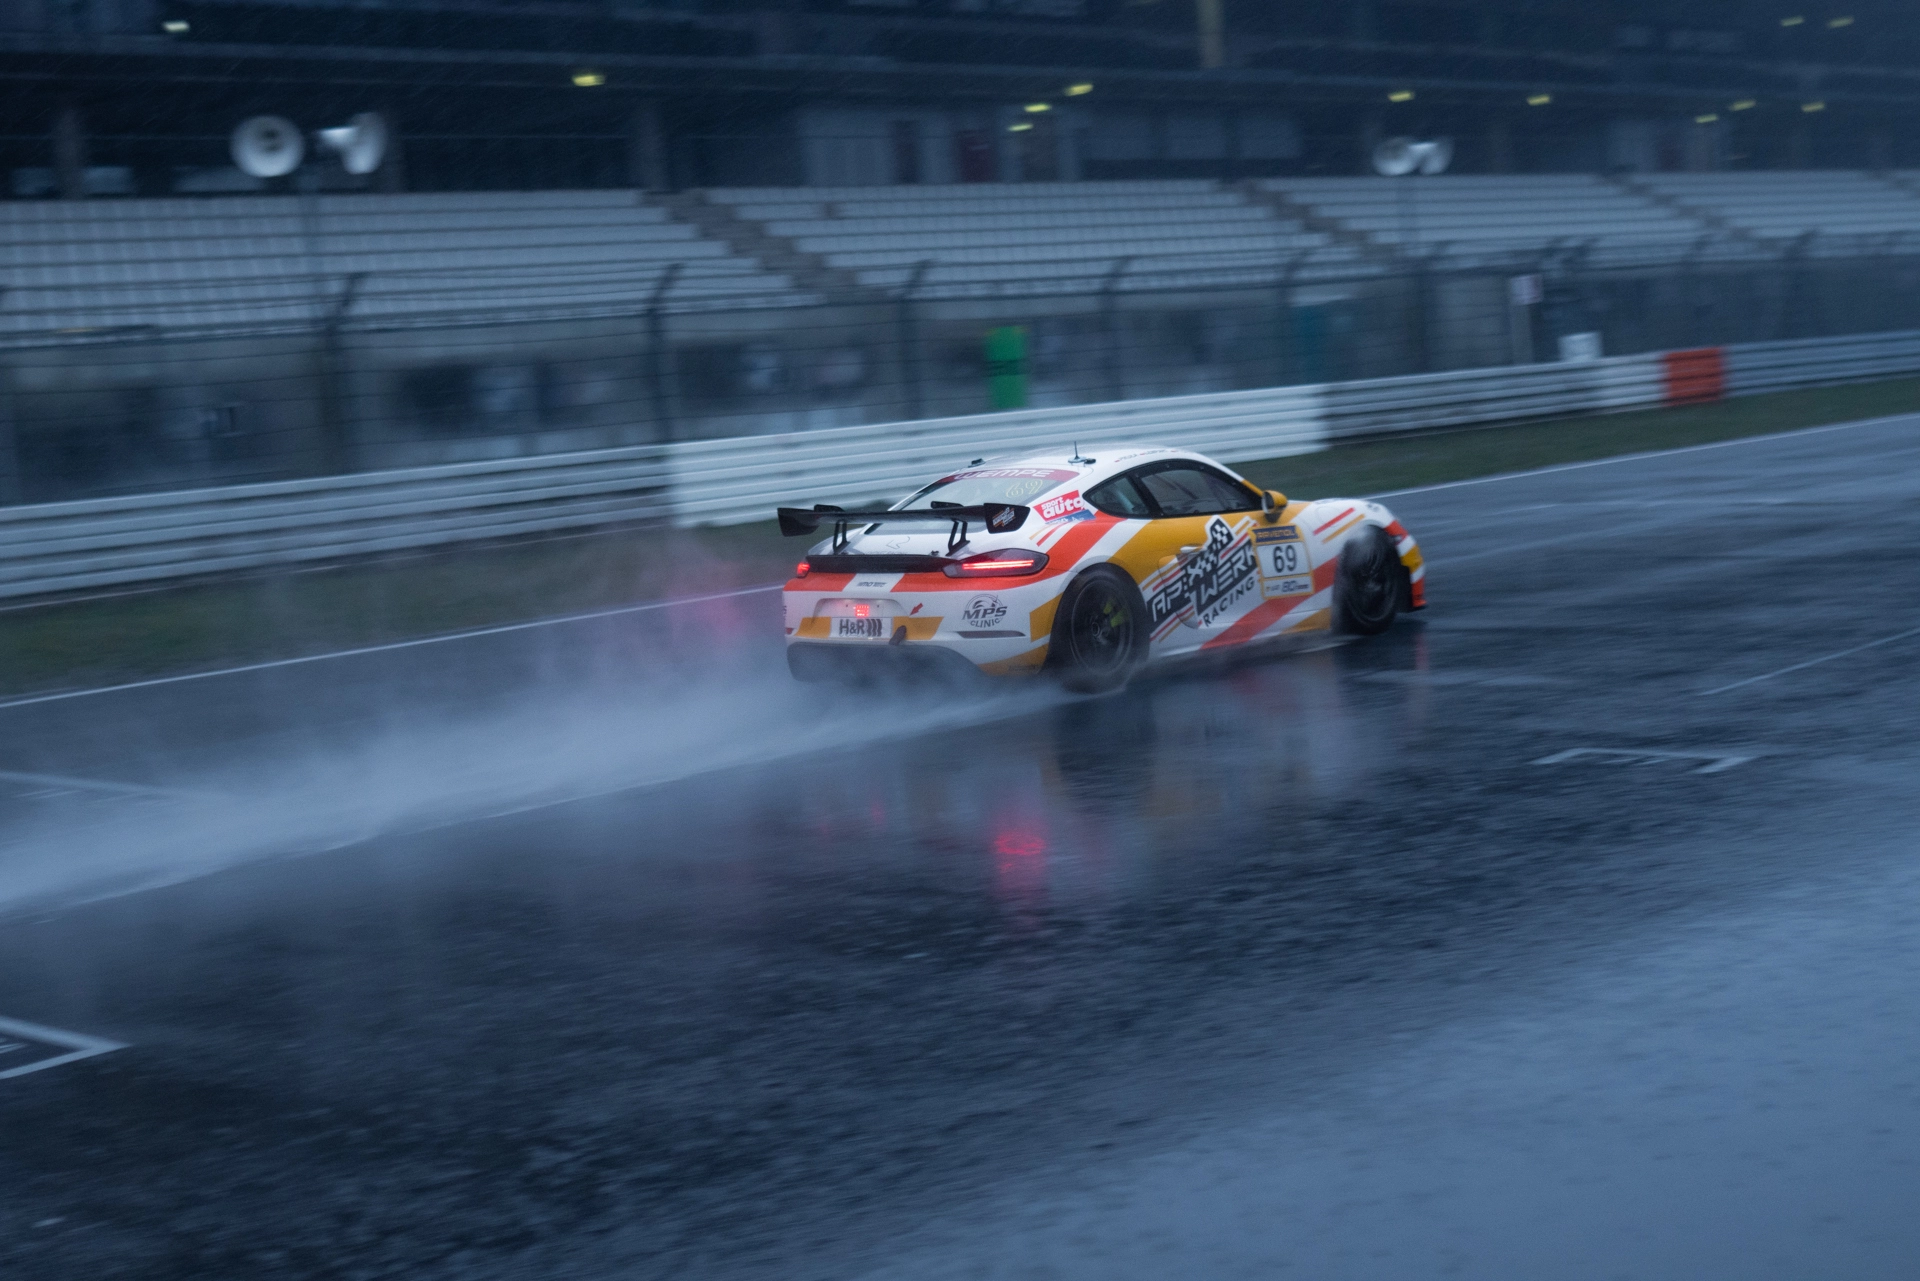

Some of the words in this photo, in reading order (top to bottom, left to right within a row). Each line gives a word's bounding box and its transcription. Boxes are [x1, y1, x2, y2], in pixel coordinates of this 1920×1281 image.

[953, 469, 1055, 480] WEMPE
[1005, 479, 1043, 498] 69
[1042, 496, 1064, 510] sport
[1043, 497, 1085, 519] auto
[1273, 544, 1298, 573] 69
[1202, 576, 1255, 628] RACING
[962, 606, 1008, 621] MPS
[838, 618, 866, 635] H&R
[970, 618, 1001, 628] CLINIC
